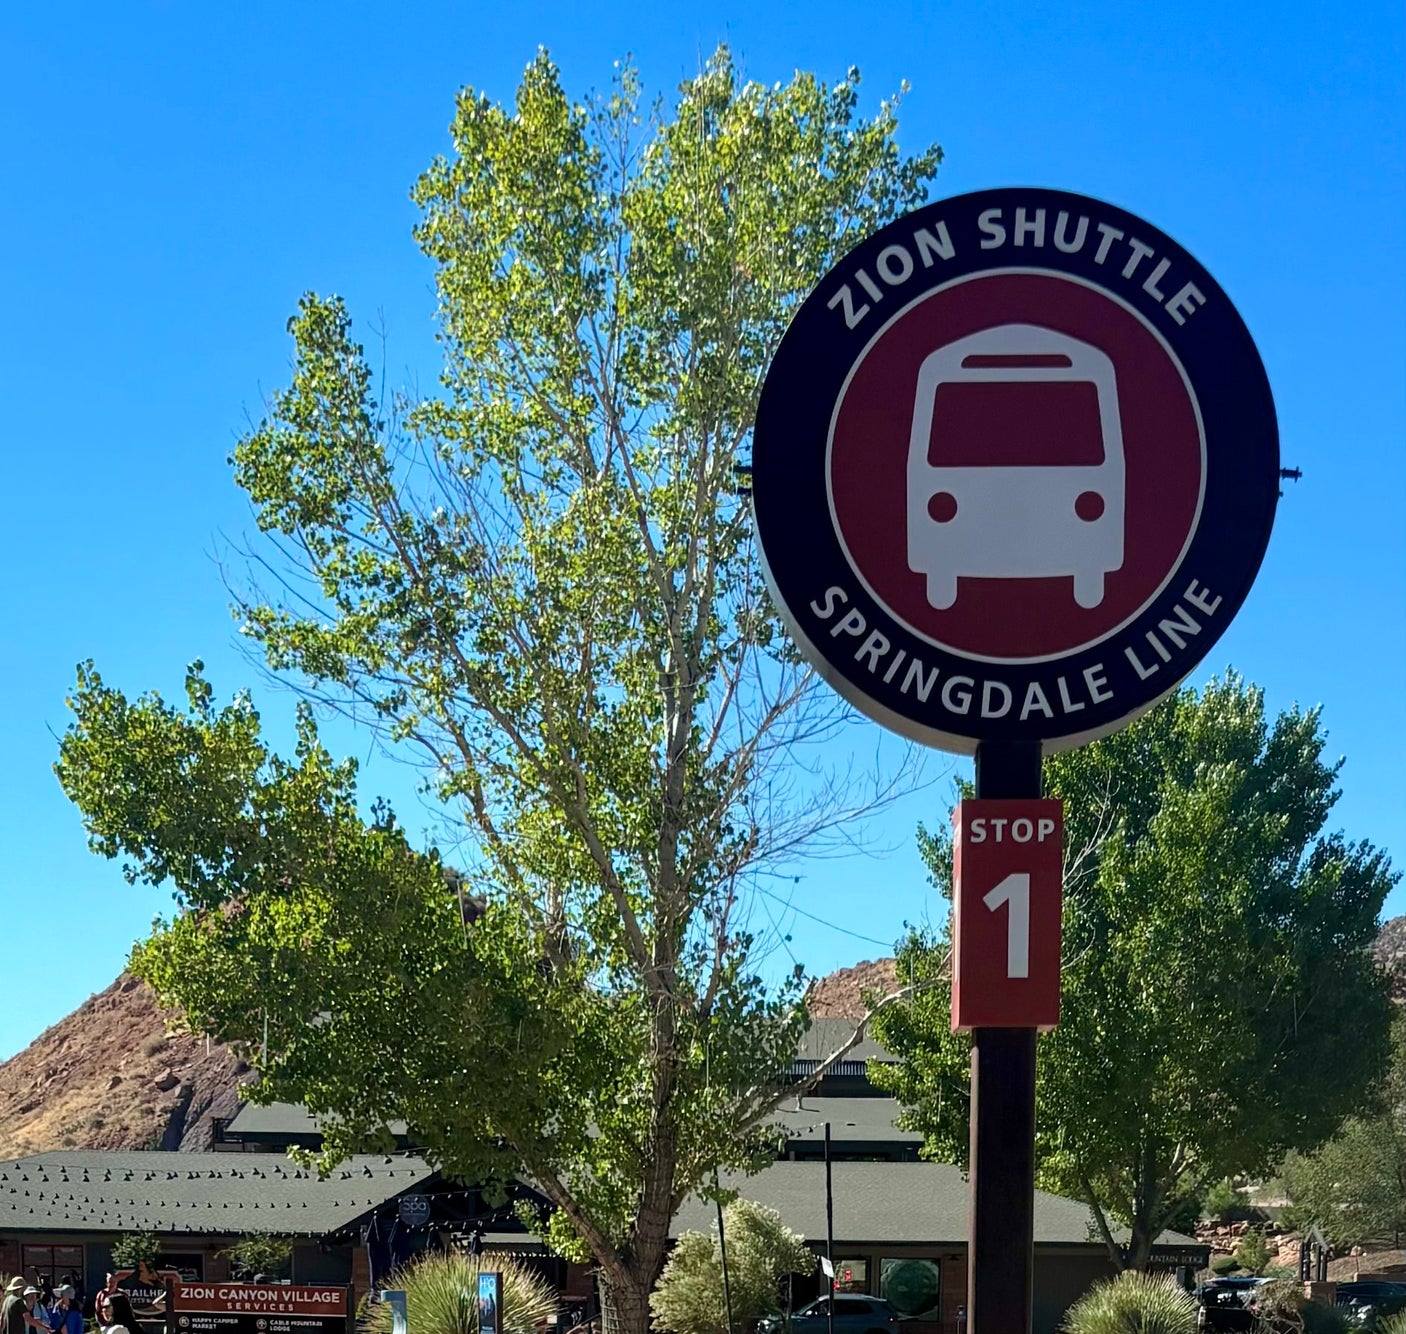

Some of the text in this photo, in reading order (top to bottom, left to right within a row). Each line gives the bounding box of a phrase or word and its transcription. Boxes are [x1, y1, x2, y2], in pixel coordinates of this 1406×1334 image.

[828, 208, 1206, 330] ZION SHUTTLE
[810, 579, 1223, 721] SPRINGDALE LINE
[970, 818, 1055, 843] STOP
[982, 872, 1031, 979] 1
[180, 1287, 340, 1303] ZION CANYON VILLAGE
[227, 1302, 294, 1312] SERVICES
